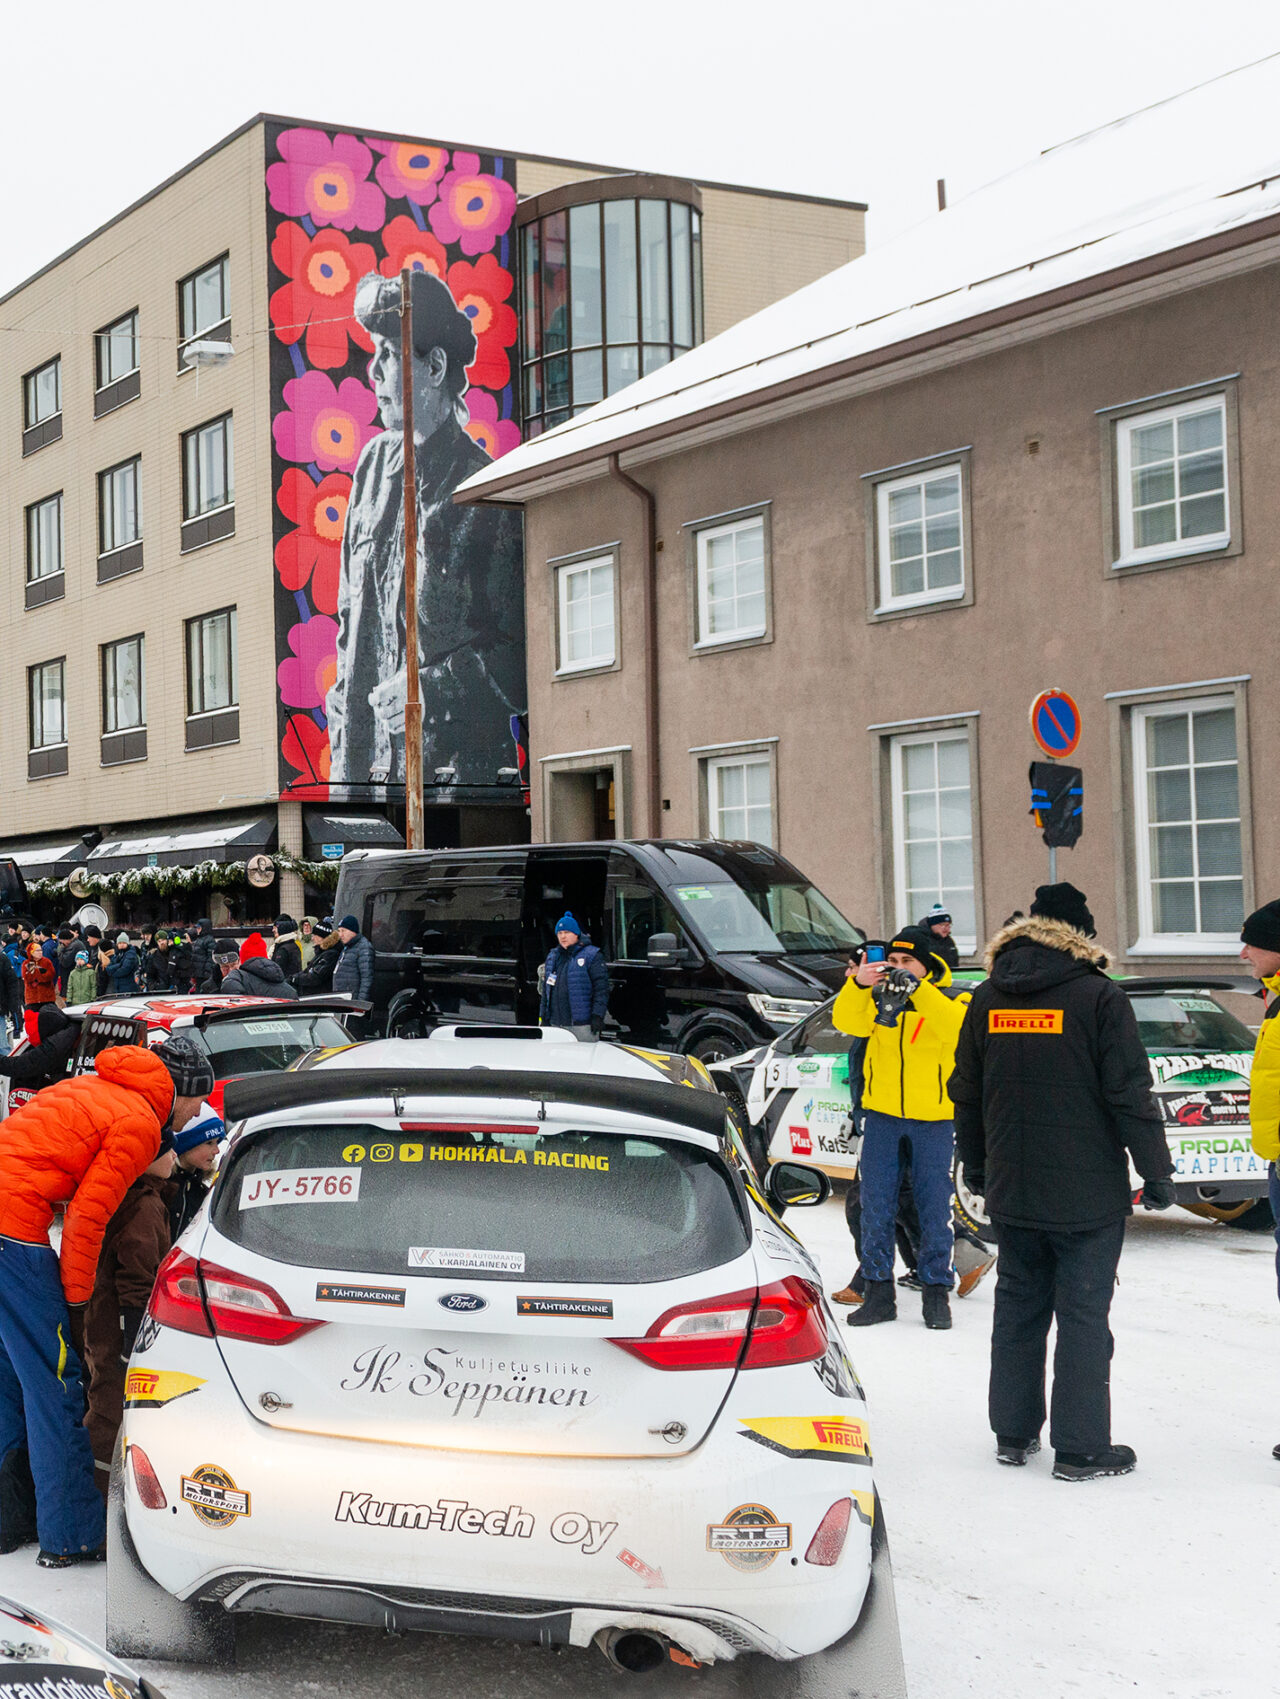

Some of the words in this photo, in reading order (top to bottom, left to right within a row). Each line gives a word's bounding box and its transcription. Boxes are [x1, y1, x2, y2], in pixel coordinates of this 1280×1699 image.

[993, 1013, 1055, 1029] PIRELLI
[1179, 1138, 1253, 1155] PROA
[429, 1145, 527, 1165] HOKKALA
[533, 1150, 610, 1172] RACING
[247, 1174, 353, 1202] JY-5766
[509, 1261, 523, 1270] OY
[331, 1287, 401, 1302] TÄHTIRAKENNE
[447, 1294, 477, 1310] Ford
[533, 1301, 609, 1314] TÄHTIRAKENNE
[455, 1356, 593, 1377] Kuljetusliike
[408, 1346, 599, 1419] Seppänen
[811, 1420, 864, 1449] PIRELLI
[185, 1491, 245, 1512] MOTORSPORT
[335, 1490, 536, 1539] Kum-Tech
[550, 1511, 619, 1555] Oy
[714, 1539, 786, 1548] MOTORSPORT
